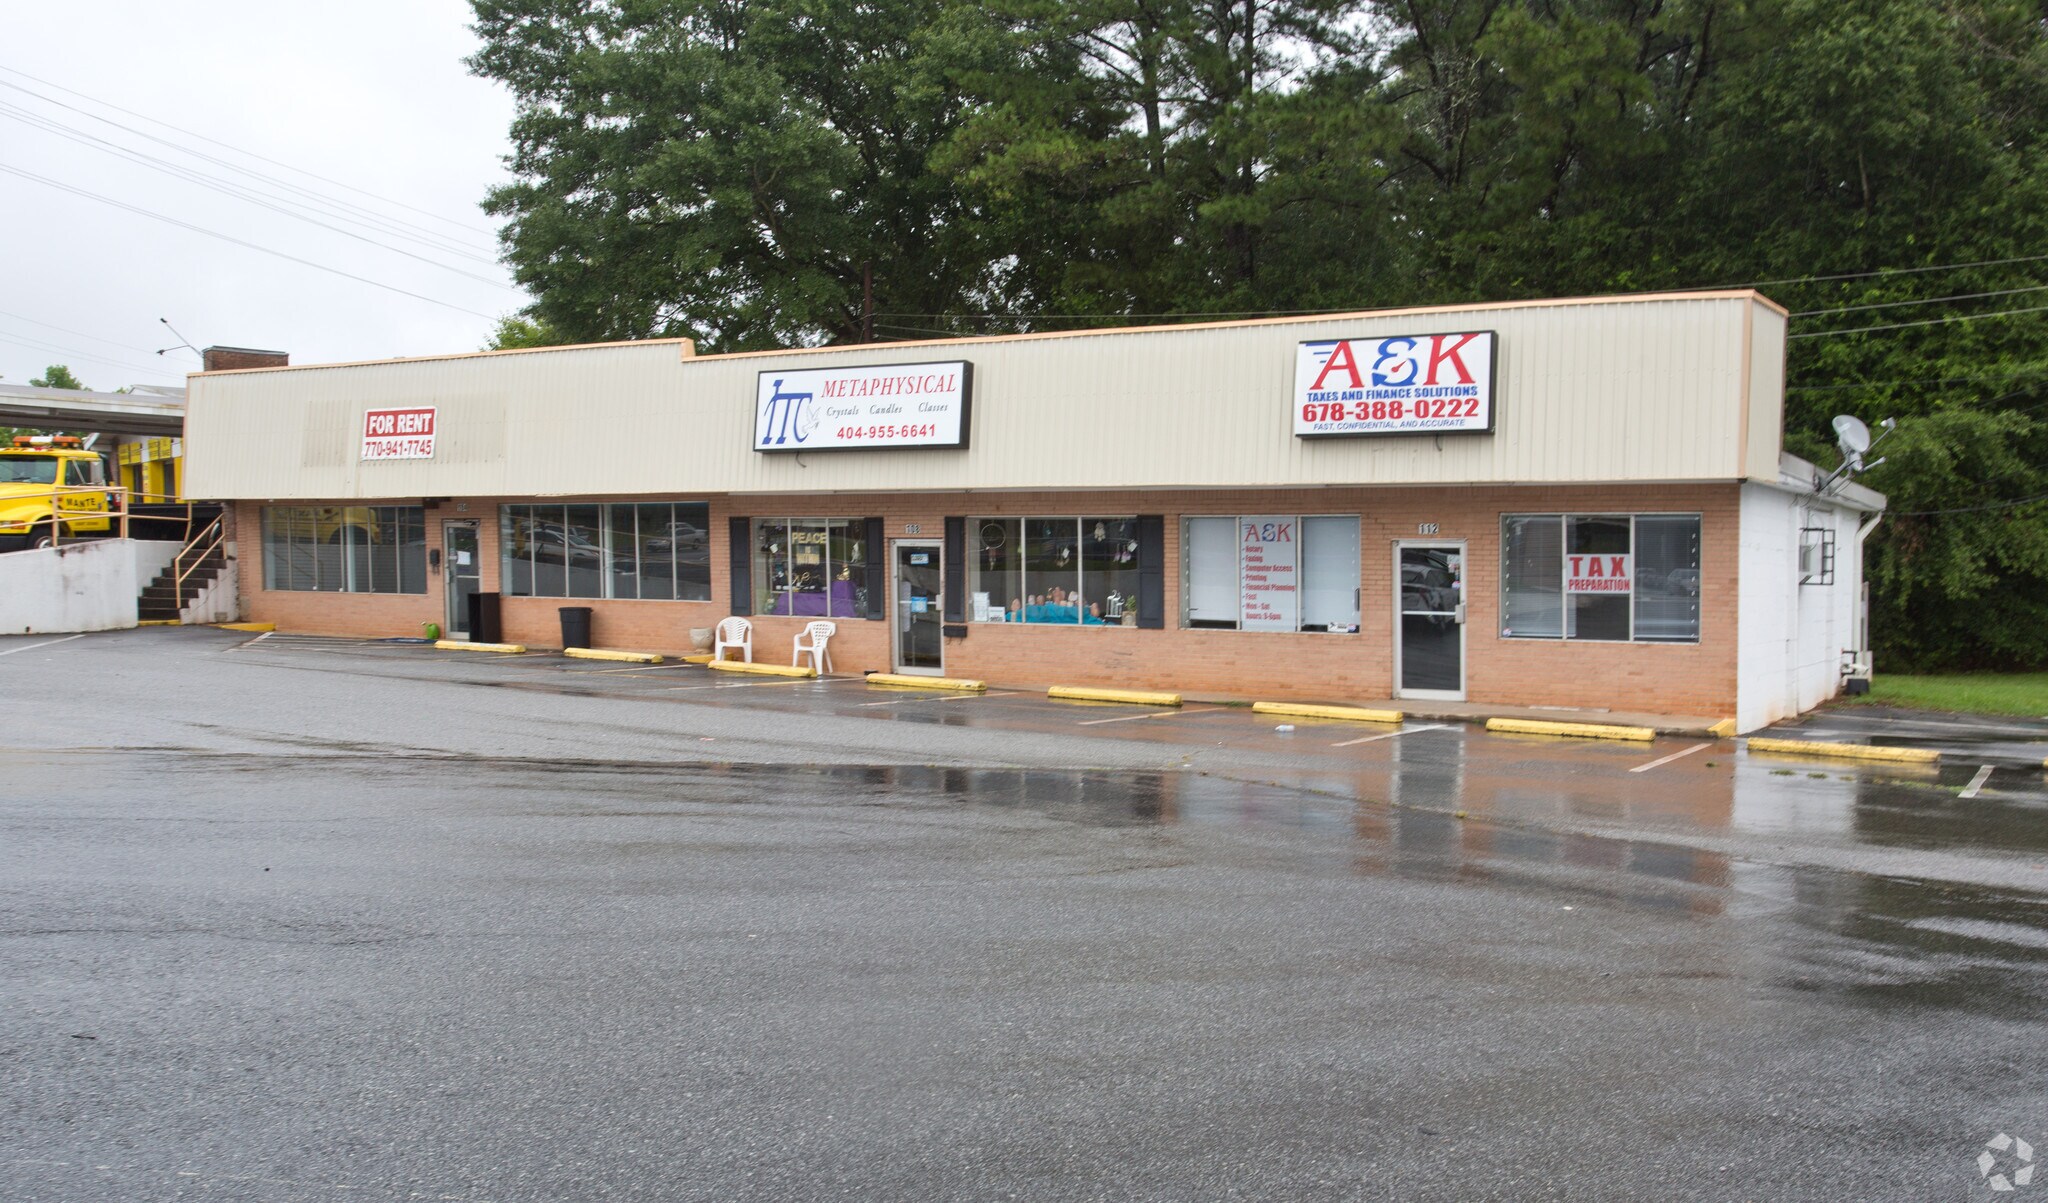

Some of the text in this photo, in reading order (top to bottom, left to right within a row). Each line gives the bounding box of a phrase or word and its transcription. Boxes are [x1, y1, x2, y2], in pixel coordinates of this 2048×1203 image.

[821, 374, 957, 398] METAPHYSICAL
[1306, 386, 1478, 402] TAXES AND FINANCE SOLUTIONS
[826, 401, 948, 419] Crystals Candles Classes
[1303, 398, 1479, 422] 678-388-0222
[368, 413, 432, 435] FOR RENT
[837, 423, 936, 440] 404-955-6641
[1313, 419, 1465, 431] FAST, CONFIDENTIAL, AND ACCURATE
[365, 440, 432, 457] 770-941-7745
[1418, 523, 1439, 535] 112
[791, 532, 827, 544] PEACE
[1245, 564, 1293, 572] Computer Access
[1569, 556, 1626, 577] TAX
[1245, 583, 1270, 591] Financial
[1568, 579, 1630, 591] PREPARATION
